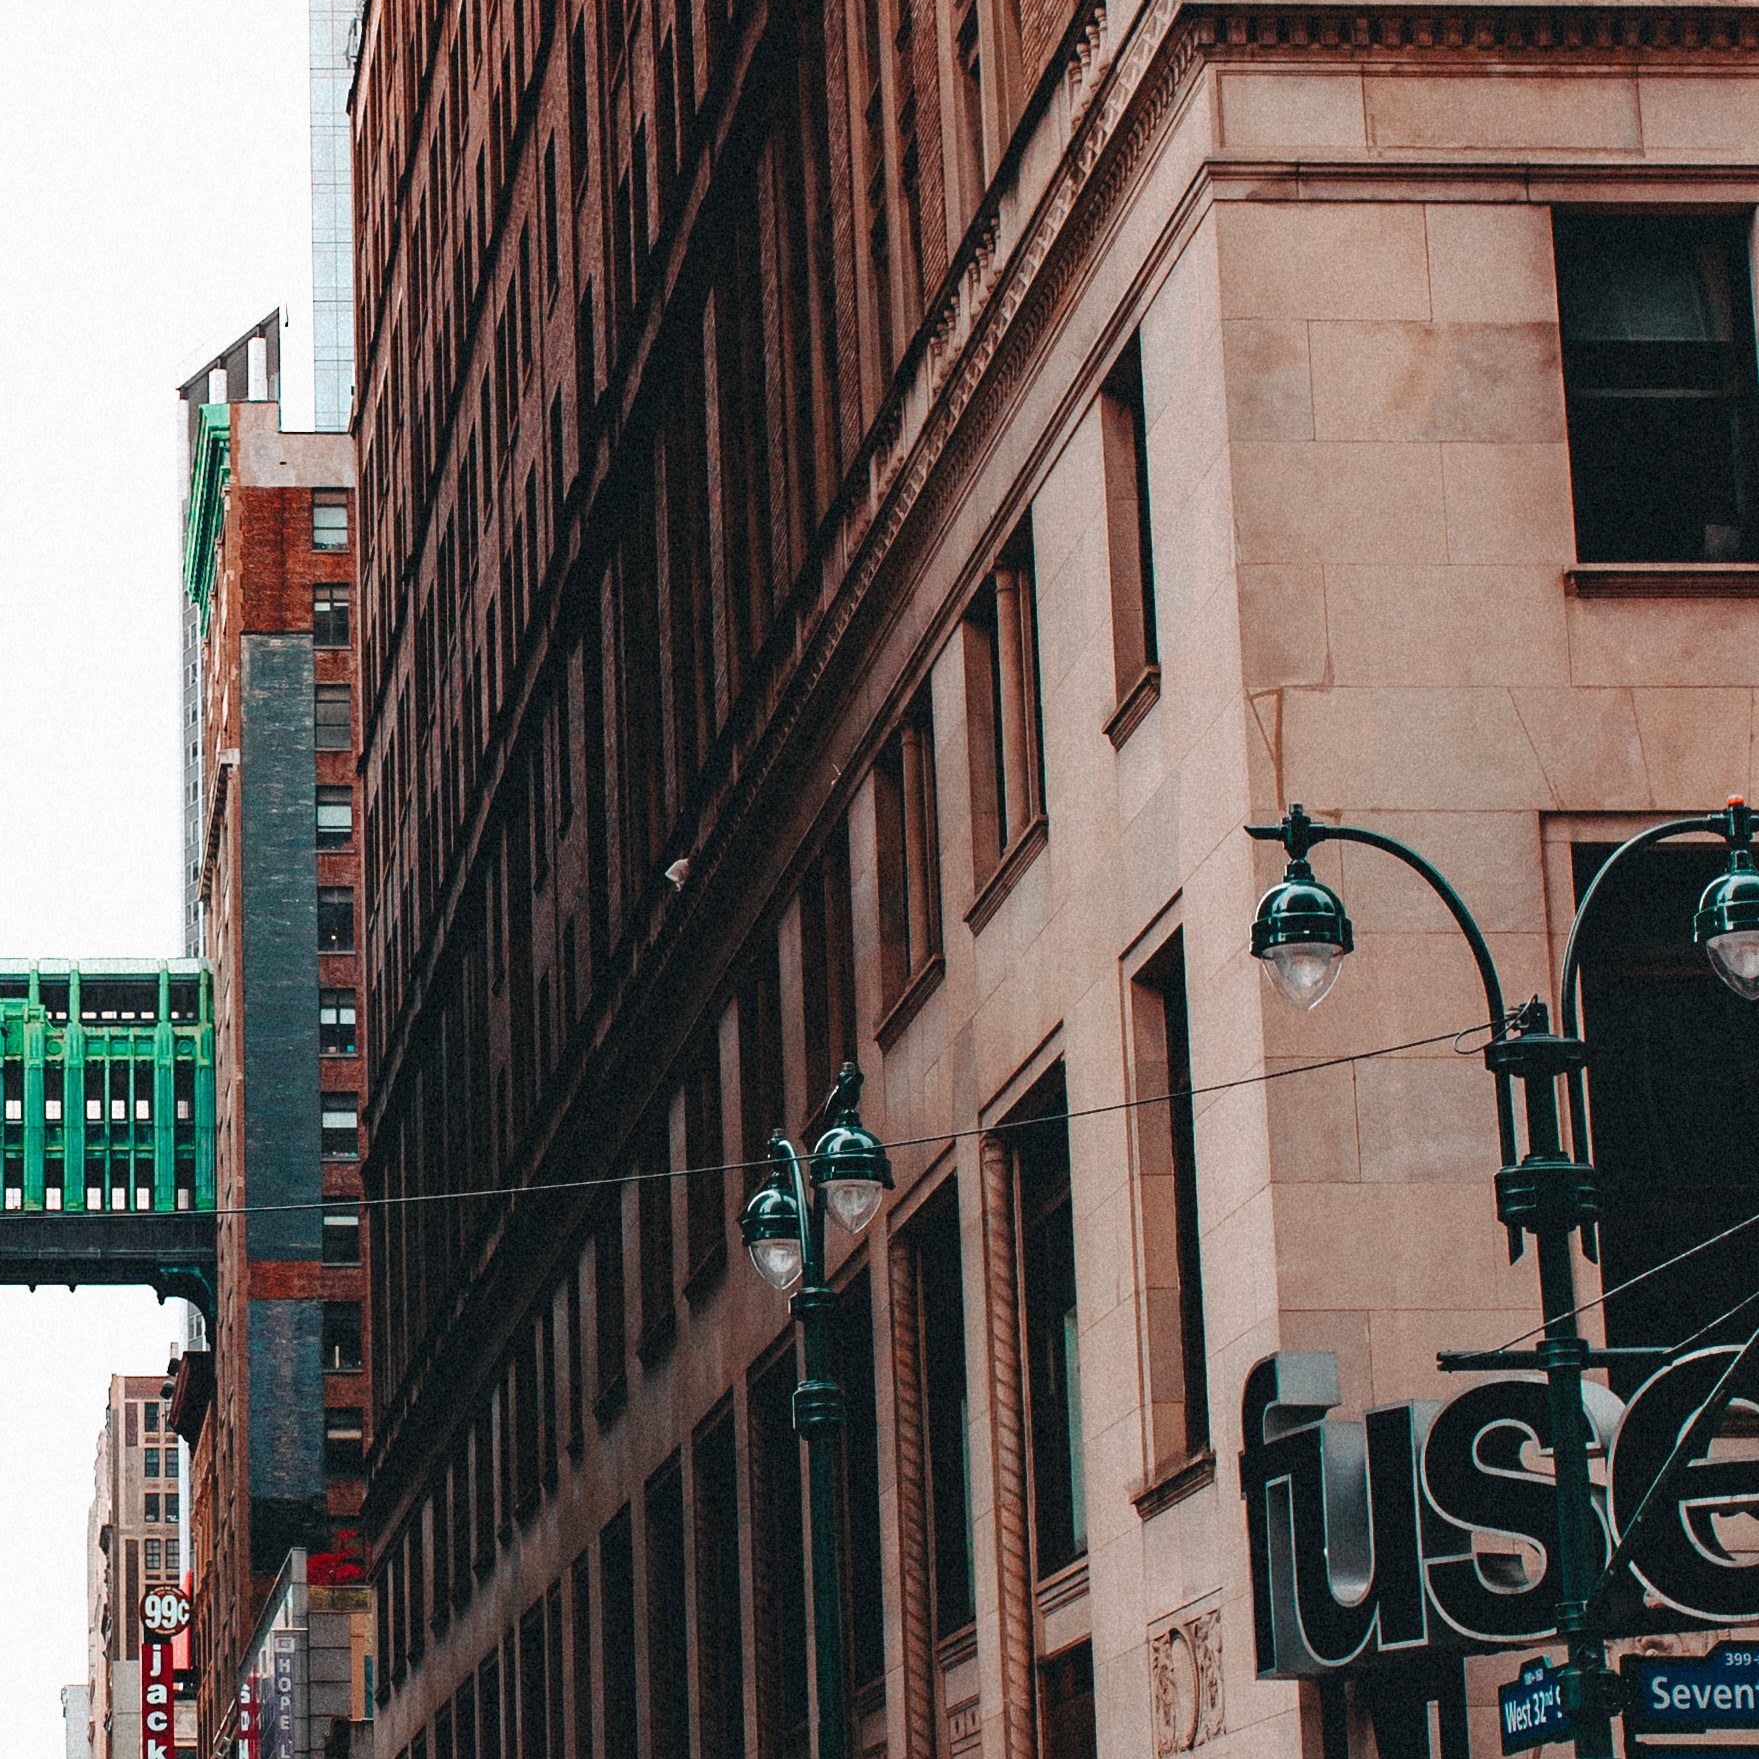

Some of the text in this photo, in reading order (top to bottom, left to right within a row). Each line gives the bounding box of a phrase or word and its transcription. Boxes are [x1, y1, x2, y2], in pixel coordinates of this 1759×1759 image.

[278, 1658, 293, 1730] HOPE
[1504, 1698, 1533, 1733] West
[1532, 1684, 1553, 1726] 32nd
[1651, 1677, 1759, 1710] Seven
